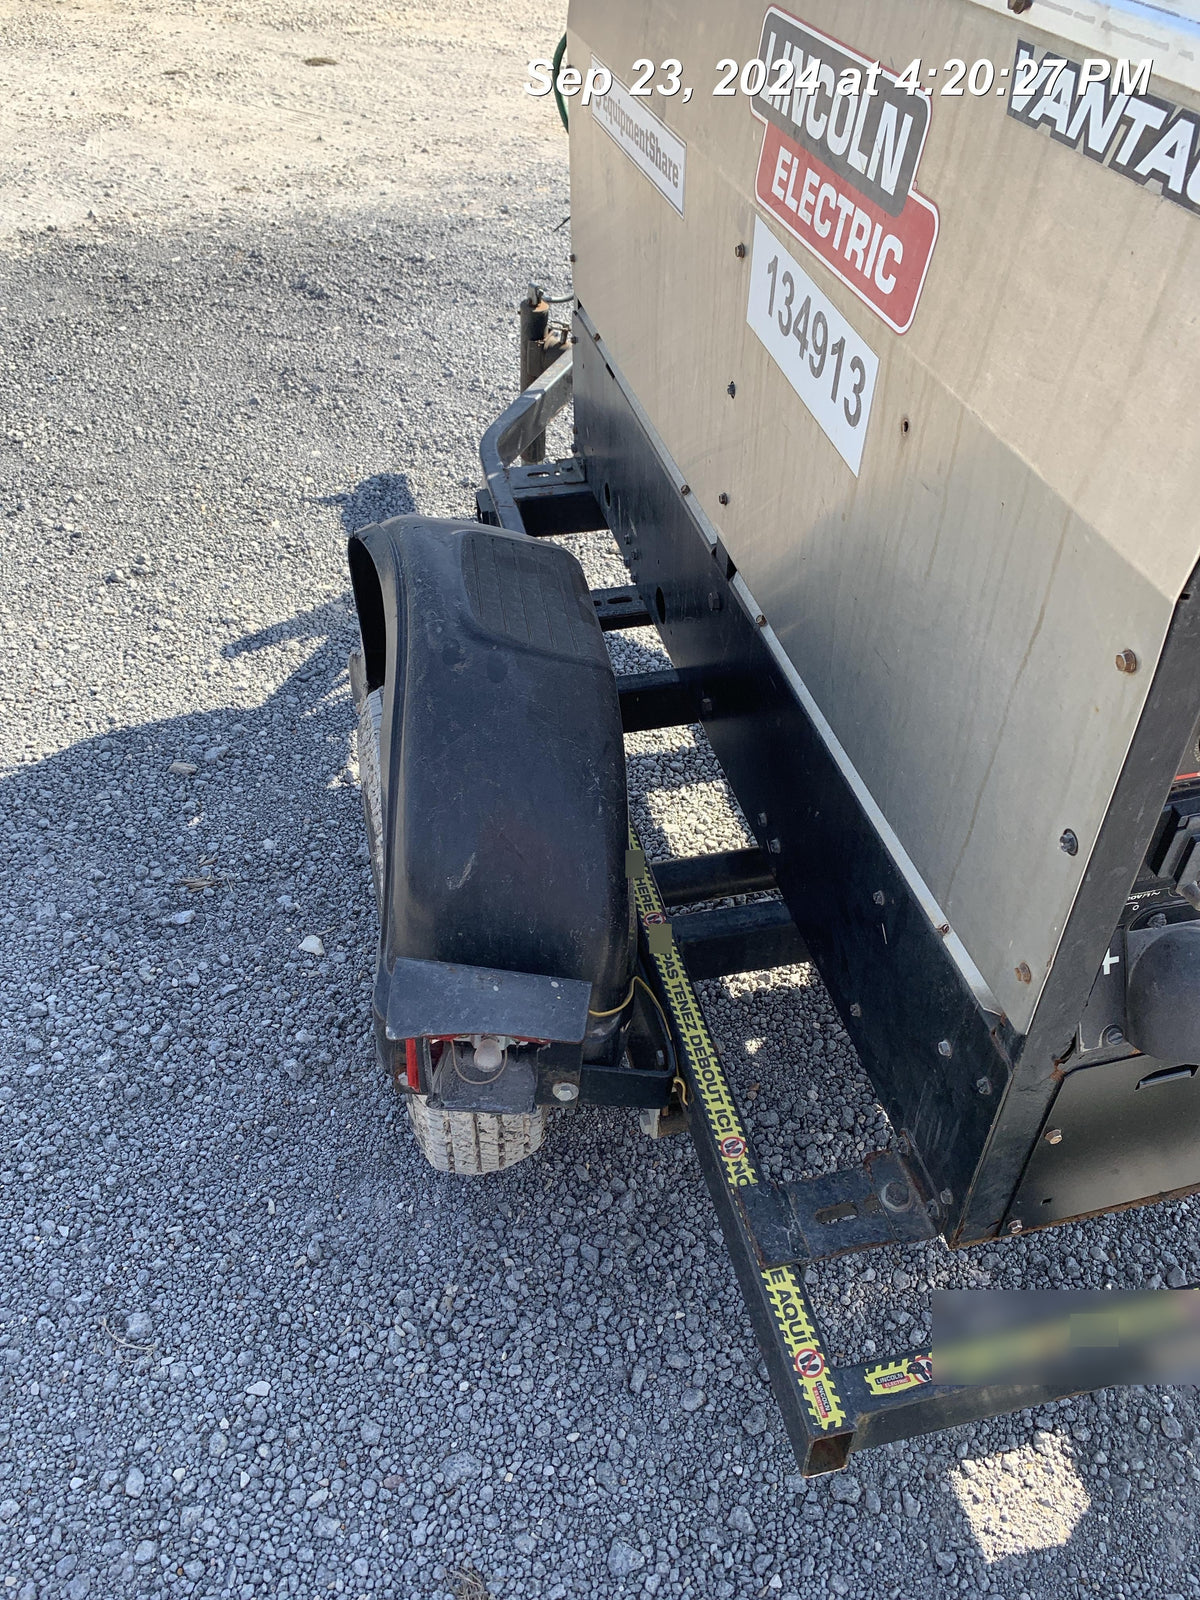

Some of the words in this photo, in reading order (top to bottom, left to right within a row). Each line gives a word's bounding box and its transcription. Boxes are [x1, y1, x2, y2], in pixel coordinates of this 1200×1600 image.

[759, 31, 914, 197] LINCOLN
[1010, 48, 1200, 204] VANTA
[771, 145, 904, 295] ELECTRIC
[767, 255, 867, 428] 134913
[635, 877, 656, 913] HERE
[663, 952, 680, 980] PAS
[672, 981, 698, 1031] TENEZ
[689, 1035, 724, 1105] DEBOUT
[714, 1108, 734, 1134] ICI
[816, 1382, 831, 1411] LINCOLN
[876, 1373, 904, 1384] LINCOLN
[885, 1378, 909, 1388] ELECTRIC
